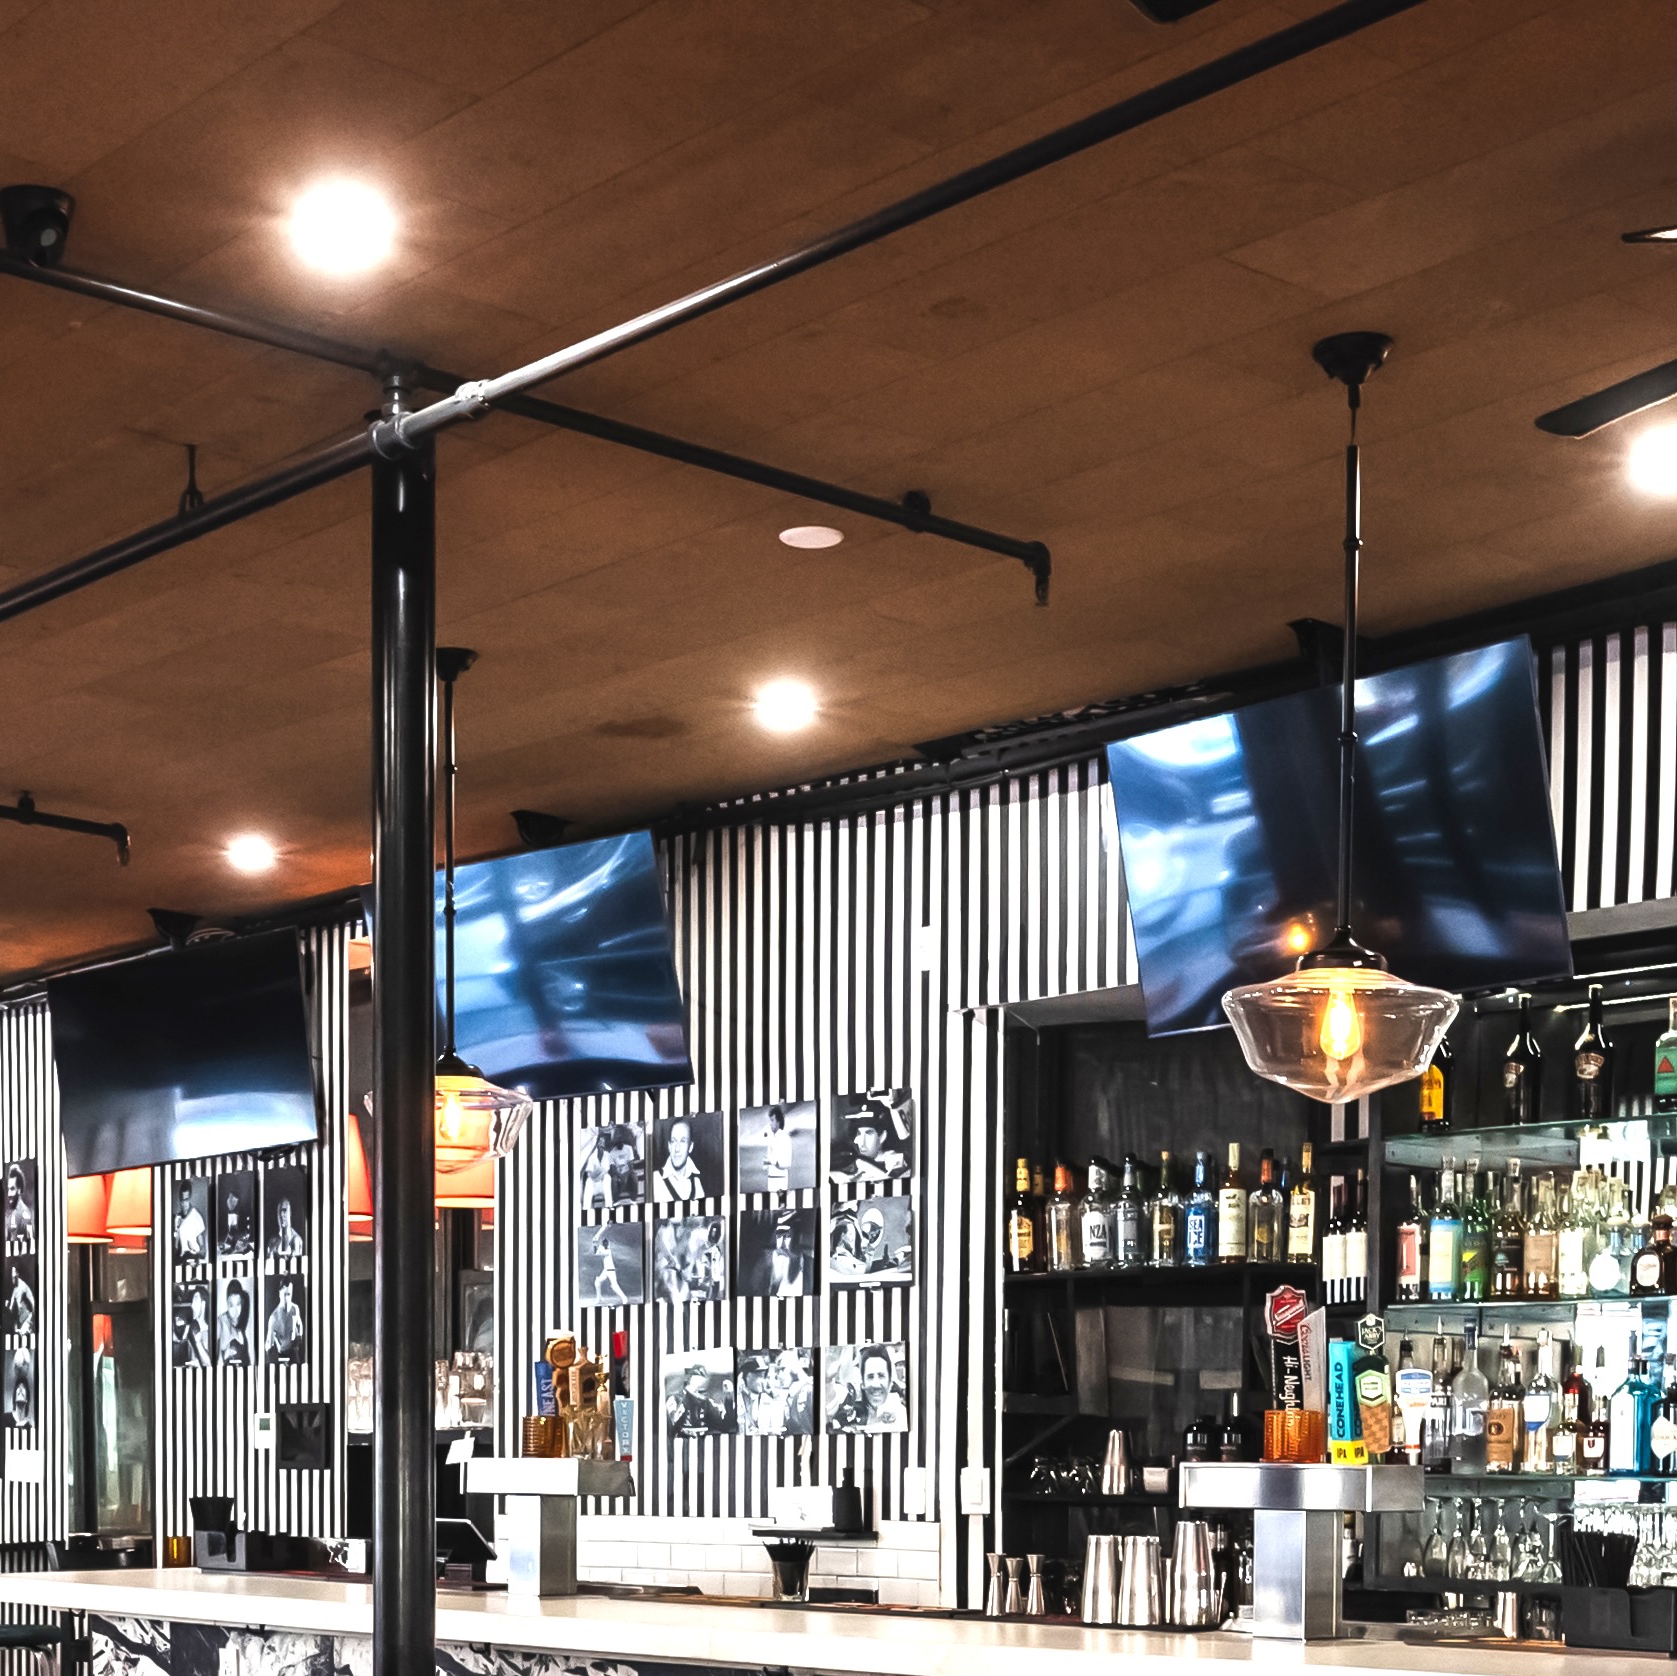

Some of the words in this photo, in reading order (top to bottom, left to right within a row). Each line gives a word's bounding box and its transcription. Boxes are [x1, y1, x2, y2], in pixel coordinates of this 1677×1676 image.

[1333, 1361, 1345, 1438] CONEHEAD
[620, 1401, 630, 1453] VICTORY
[1337, 1448, 1348, 1460] IPA
[1354, 1446, 1365, 1458] IPA
